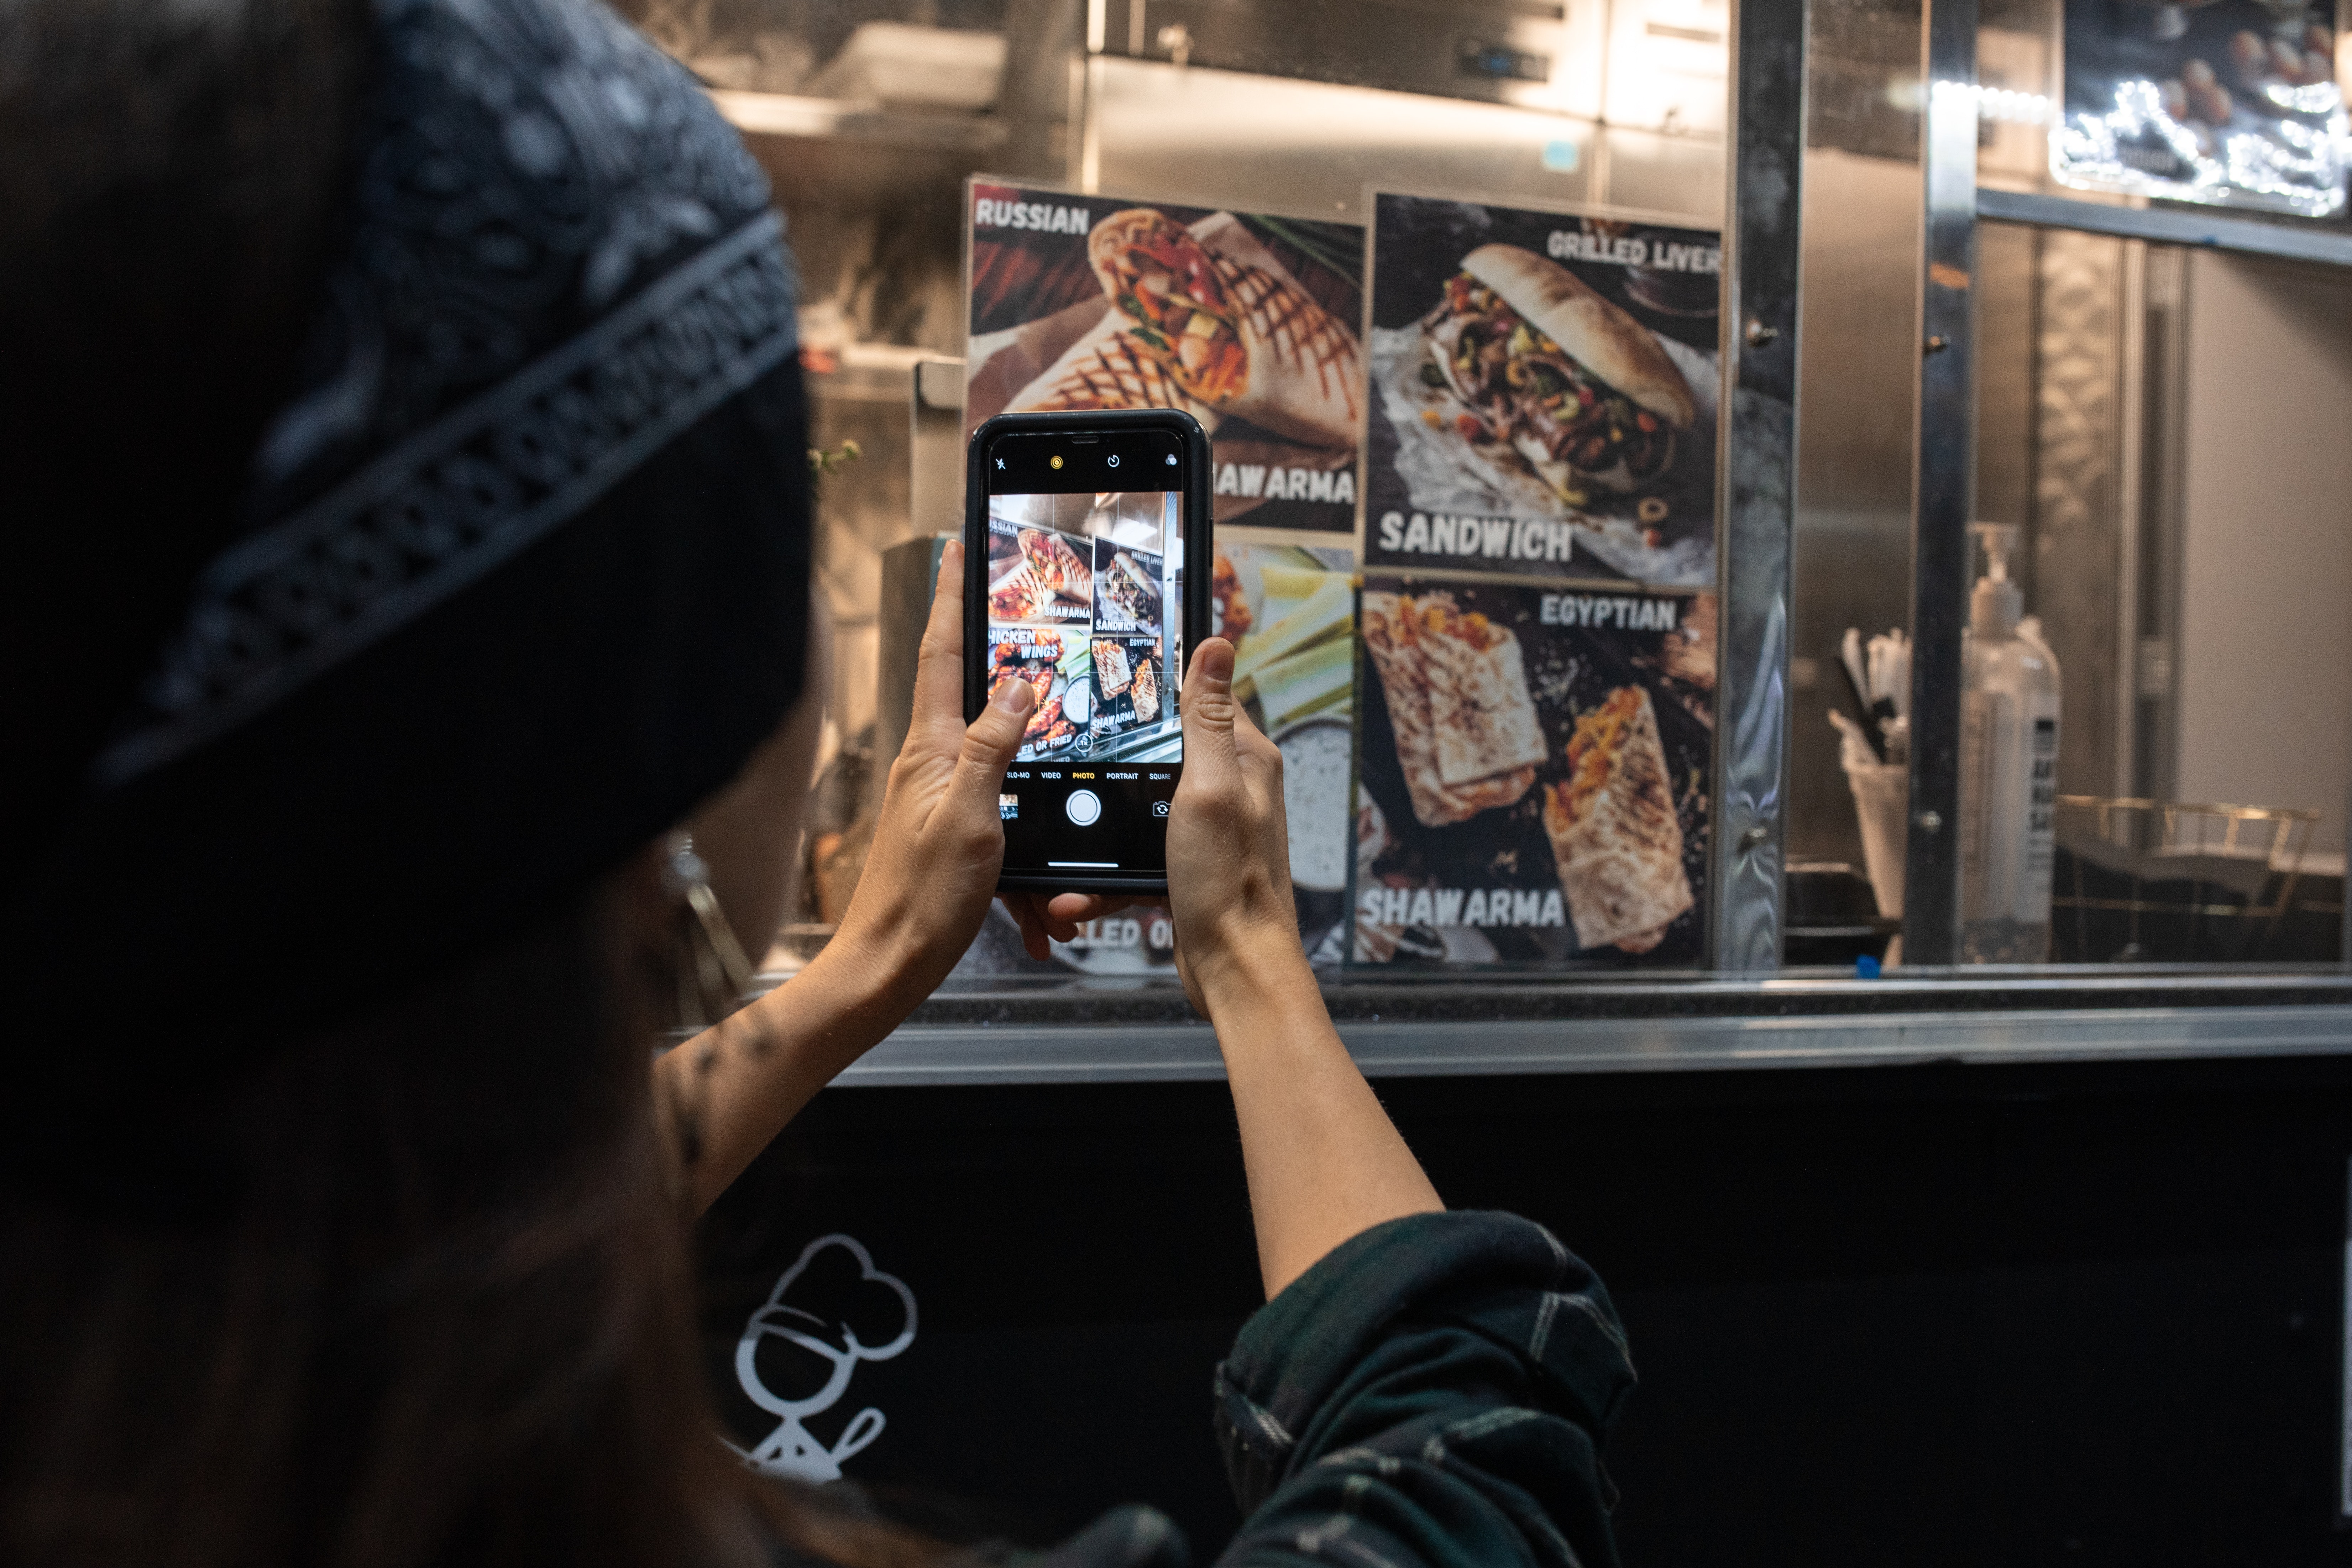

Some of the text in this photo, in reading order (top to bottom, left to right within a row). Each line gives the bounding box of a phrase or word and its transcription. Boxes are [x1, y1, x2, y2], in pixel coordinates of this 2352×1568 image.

[975, 199, 1090, 235] RUSSIAN
[1547, 230, 1722, 273] GRILLED LIVER
[1379, 512, 1573, 562] SANDWICH
[1044, 606, 1090, 619] SHAWARMA
[1540, 595, 1677, 631] EGYPTIAN
[1096, 619, 1136, 631] SANDWICH
[1021, 645, 1058, 659] WINGS
[1130, 638, 1155, 647] EGYPTIAN
[1091, 710, 1136, 730] SHAWARMA
[1036, 740, 1047, 751] OR
[1049, 734, 1072, 748] FRIED
[1361, 888, 1566, 928] SHAWARMA
